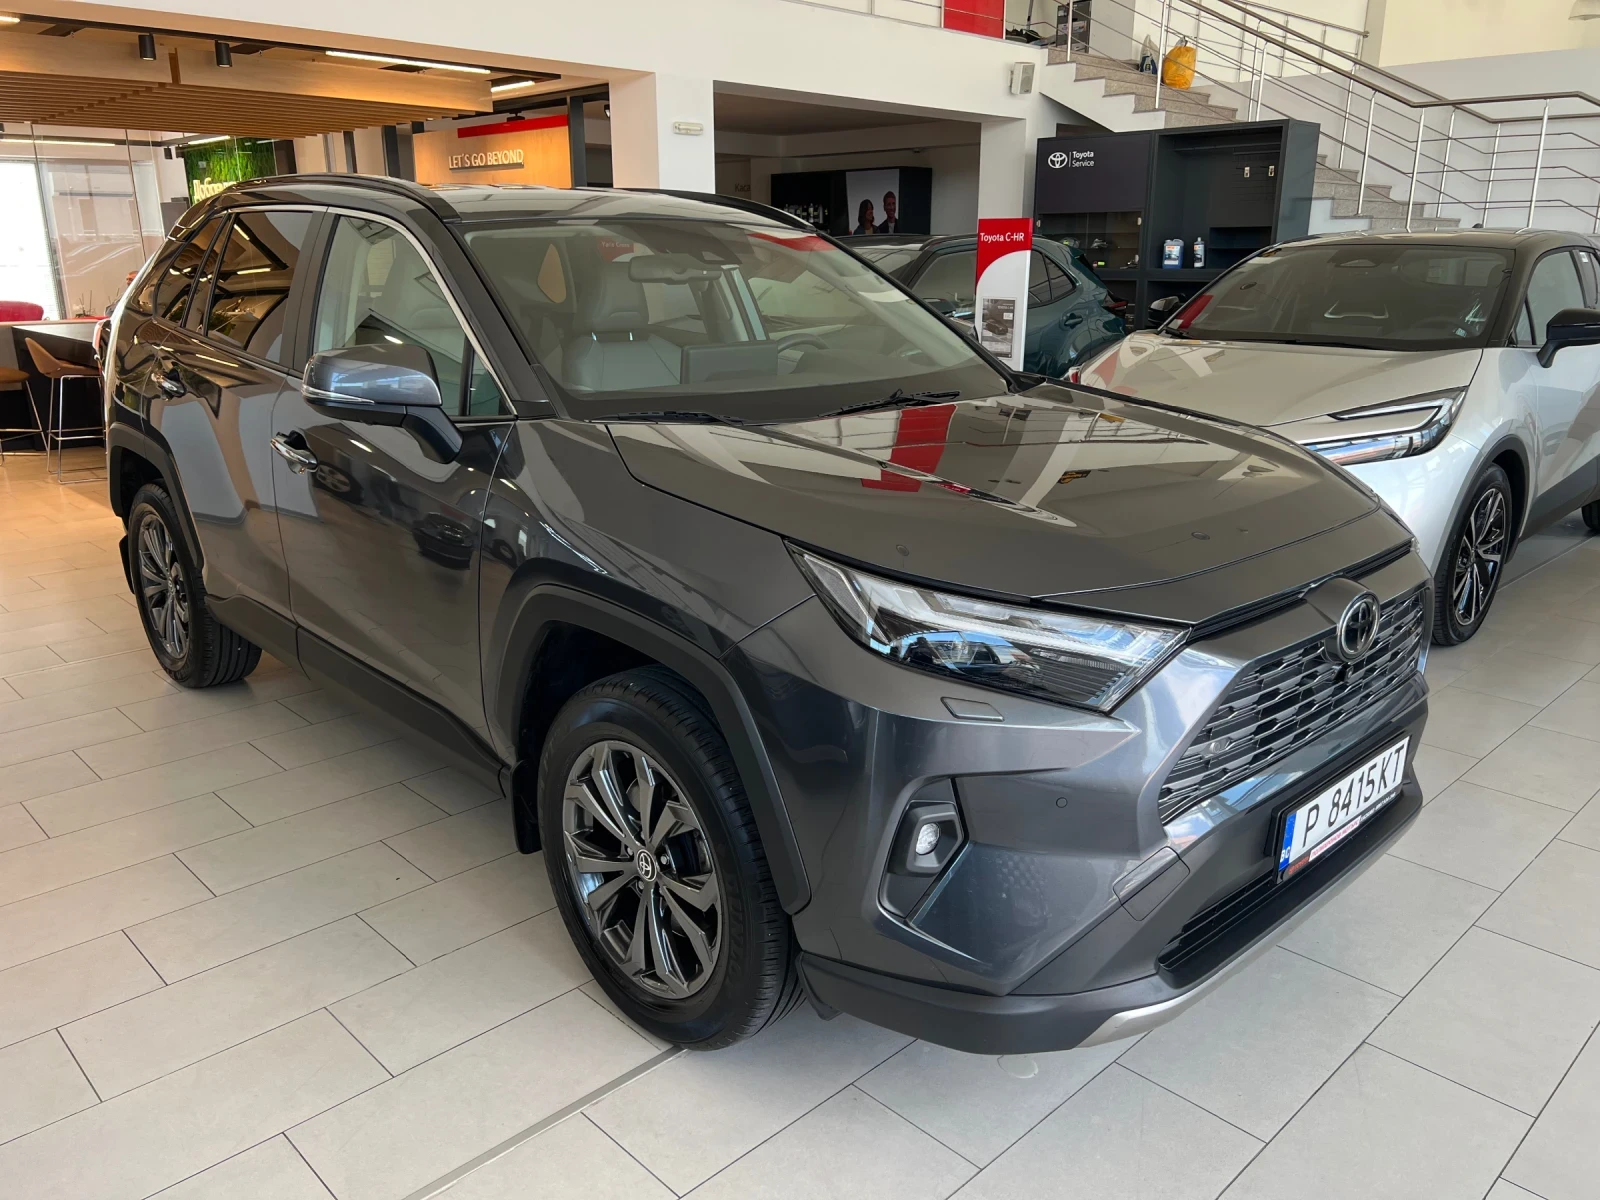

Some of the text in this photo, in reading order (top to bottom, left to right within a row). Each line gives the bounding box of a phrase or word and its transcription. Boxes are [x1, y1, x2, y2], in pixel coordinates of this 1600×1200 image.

[471, 152, 486, 167] GO
[487, 149, 524, 165] BEYOND
[1072, 151, 1094, 160] Toyota
[1072, 160, 1095, 168] Service
[980, 232, 1025, 244] Toyota C-HR
[1302, 803, 1320, 848] P
